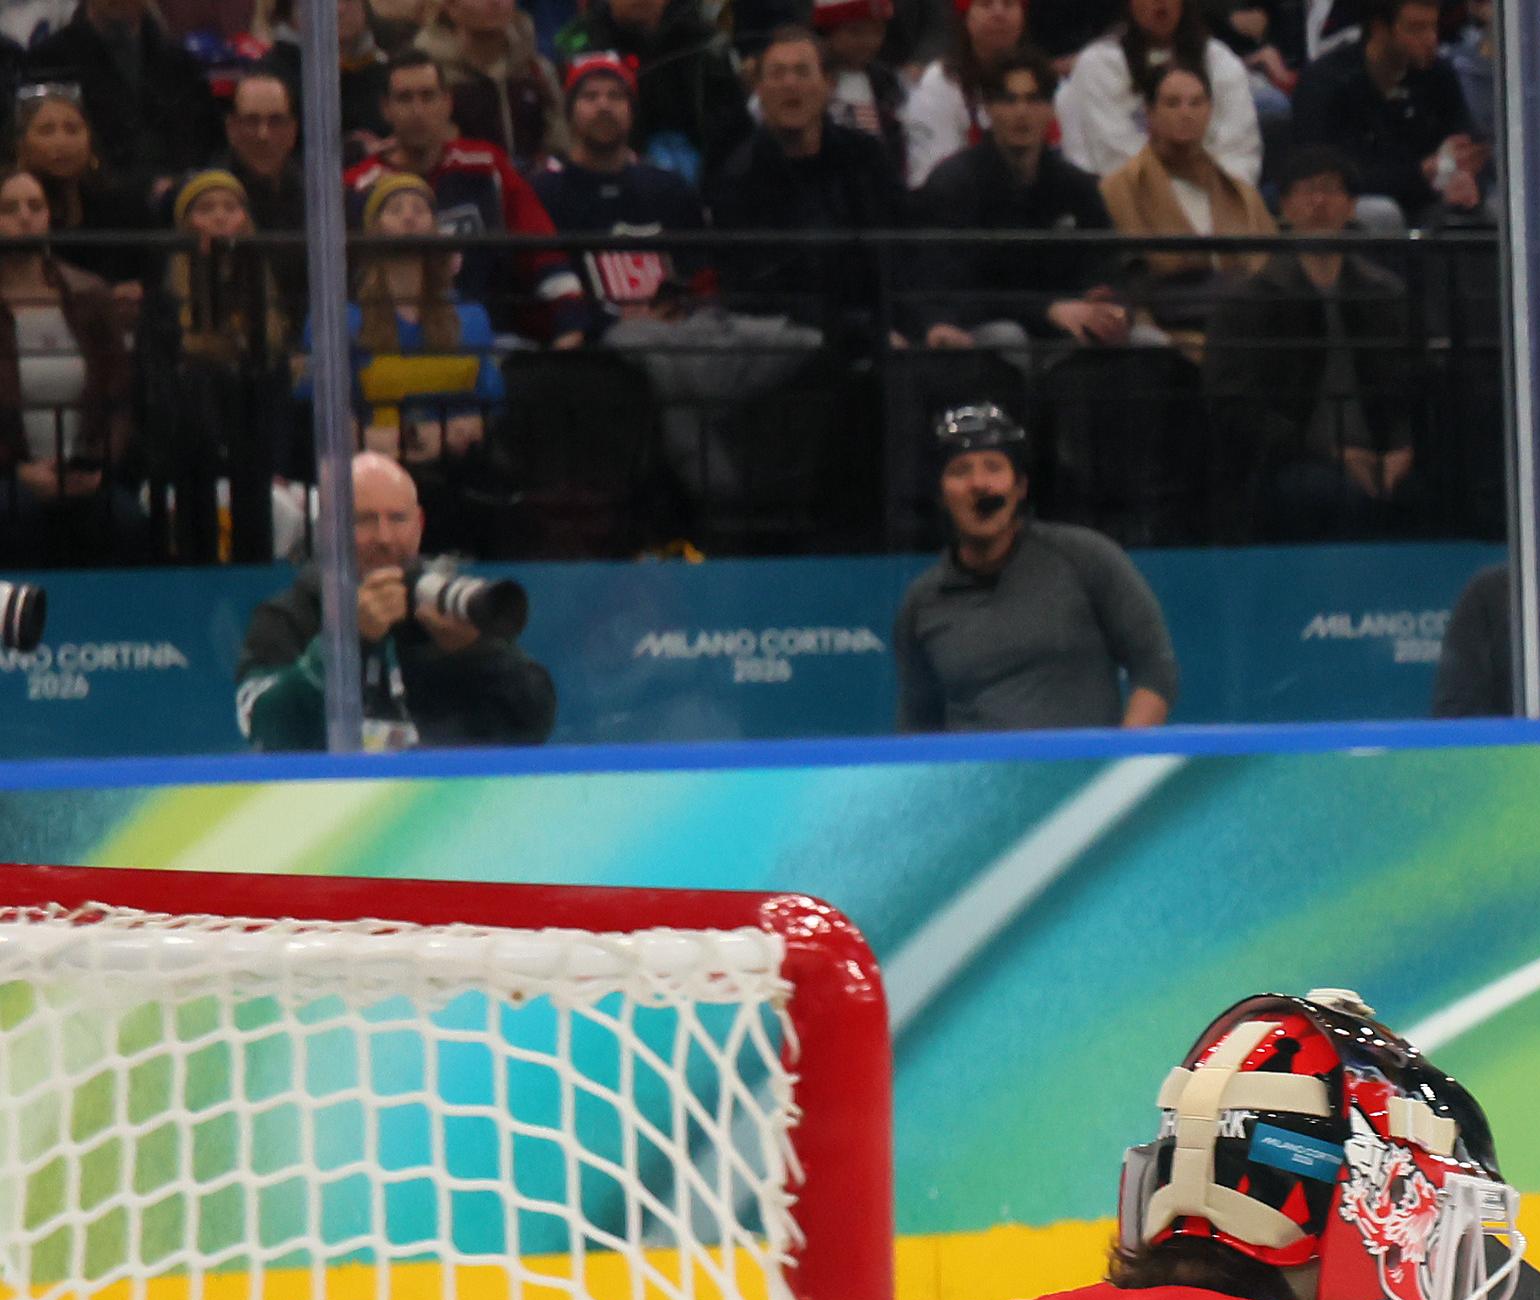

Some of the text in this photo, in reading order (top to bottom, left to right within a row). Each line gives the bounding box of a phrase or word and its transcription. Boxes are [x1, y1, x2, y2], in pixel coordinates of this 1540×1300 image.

[1301, 611, 1415, 640] MILANO
[57, 642, 189, 671] CORTINA
[633, 627, 886, 658] MILANO CORTINA
[28, 671, 89, 699] 2026
[733, 657, 792, 684] 2026
